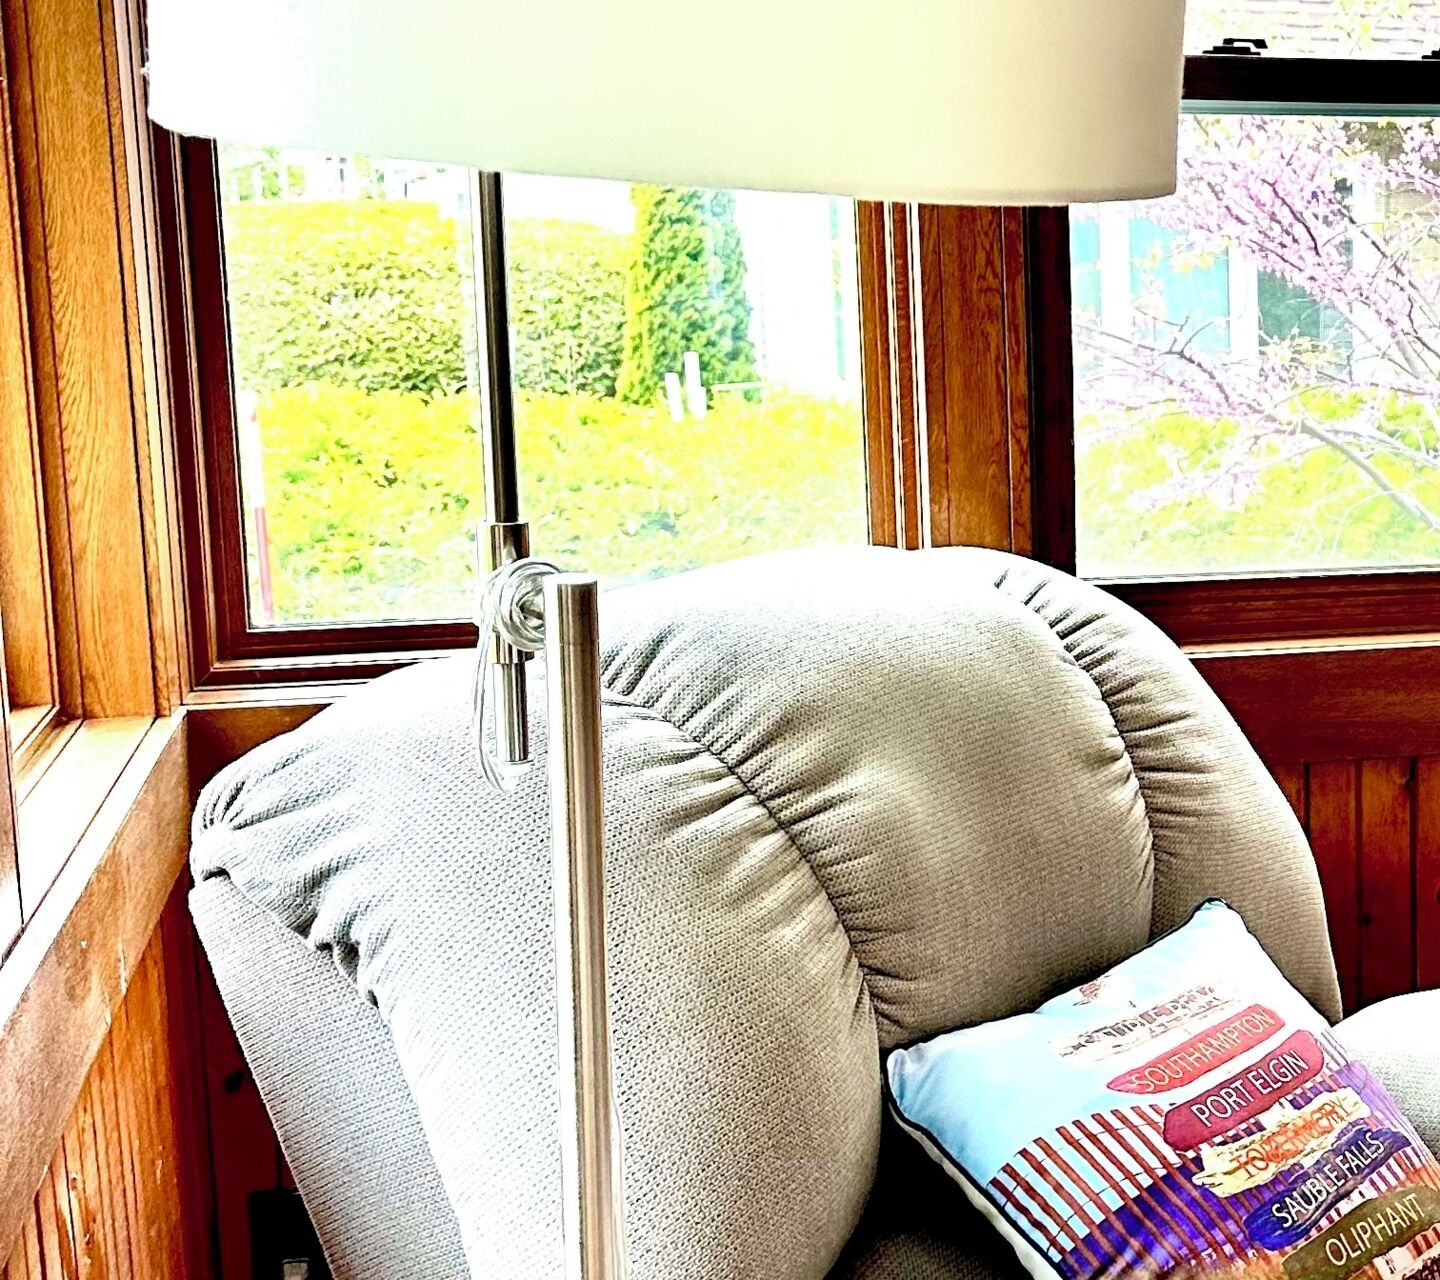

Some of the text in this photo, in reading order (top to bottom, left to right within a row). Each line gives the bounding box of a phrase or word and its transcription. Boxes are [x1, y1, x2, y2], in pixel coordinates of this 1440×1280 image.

[1131, 1009, 1276, 1092] SOUTHAMPTON
[1191, 1049, 1309, 1127] PORT ELGIN
[1272, 1131, 1384, 1228] SAUBLE FALLS
[1325, 1193, 1425, 1266] OLIPHANT
